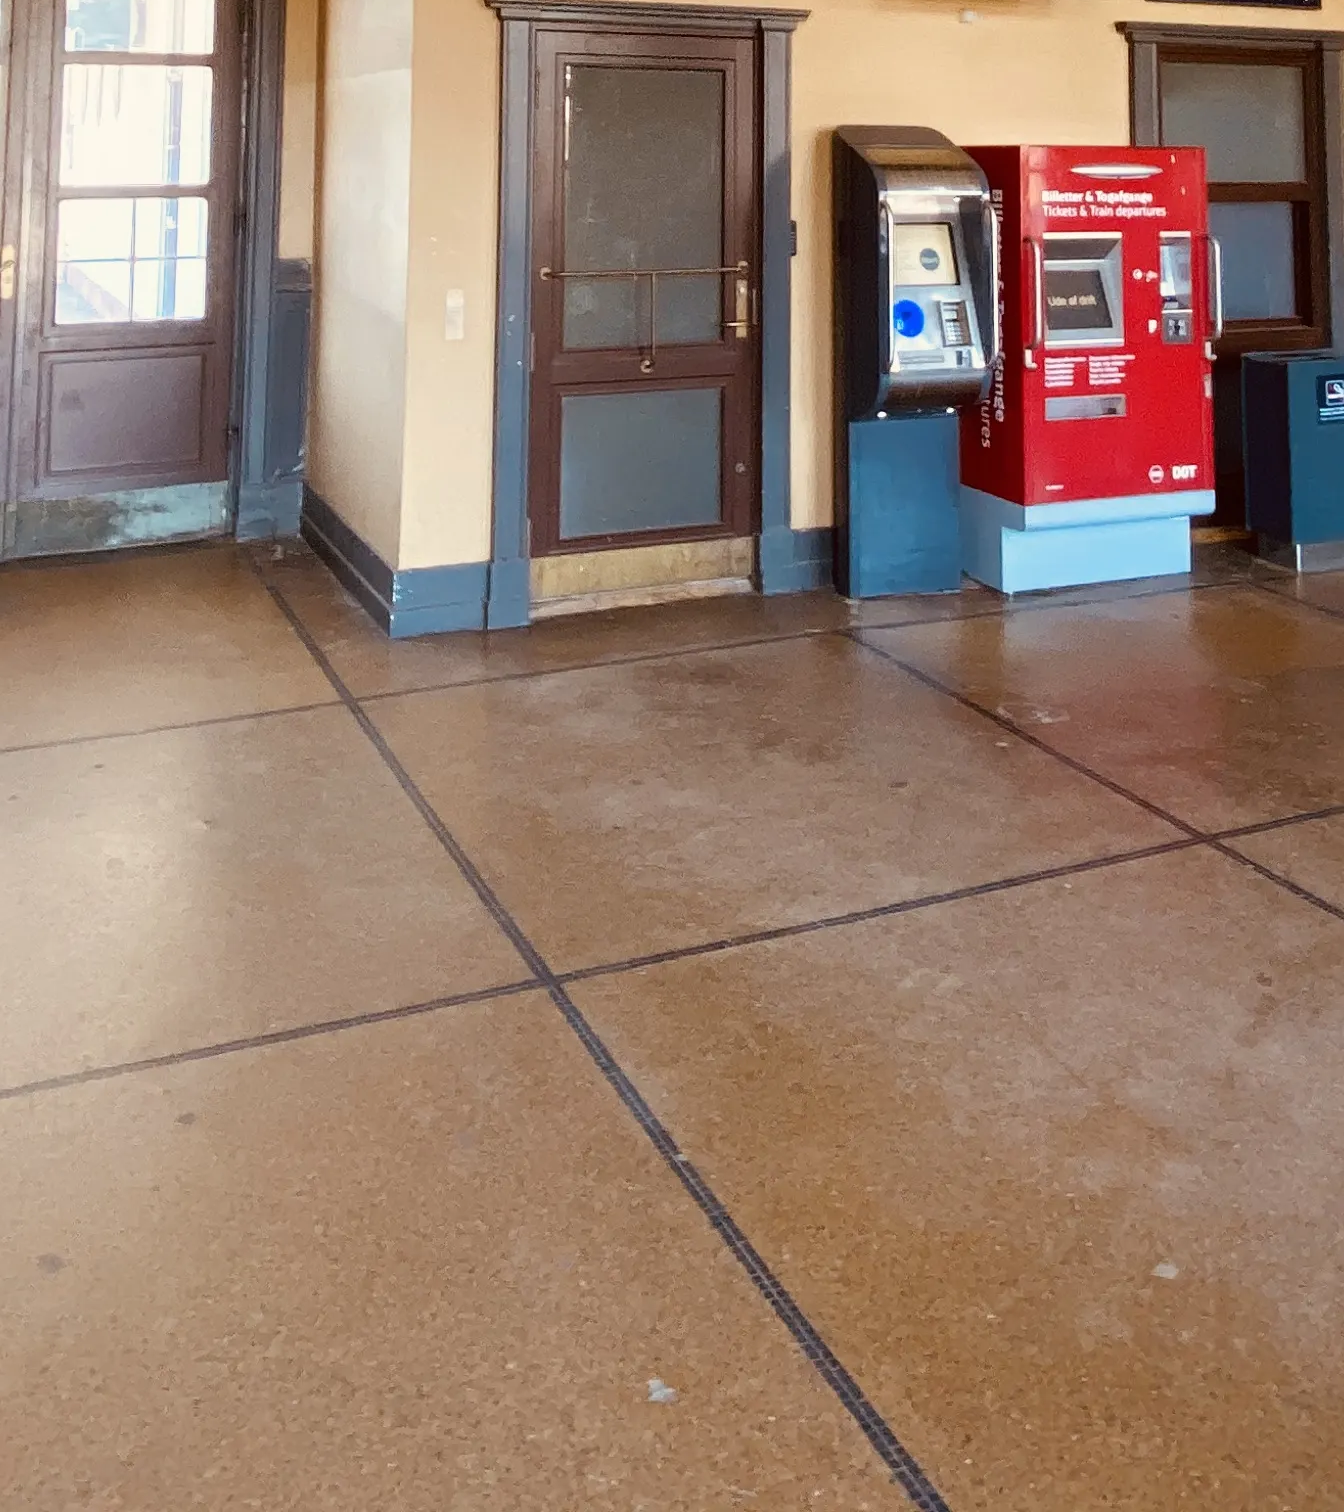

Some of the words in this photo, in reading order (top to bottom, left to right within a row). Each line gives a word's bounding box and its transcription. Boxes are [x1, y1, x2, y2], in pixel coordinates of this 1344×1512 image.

[1041, 190, 1084, 202] Billetter
[1084, 190, 1094, 202] &
[1042, 205, 1078, 217] Tickets
[1079, 205, 1088, 217] &
[1089, 205, 1114, 217] Train
[1171, 465, 1198, 479] DOT
